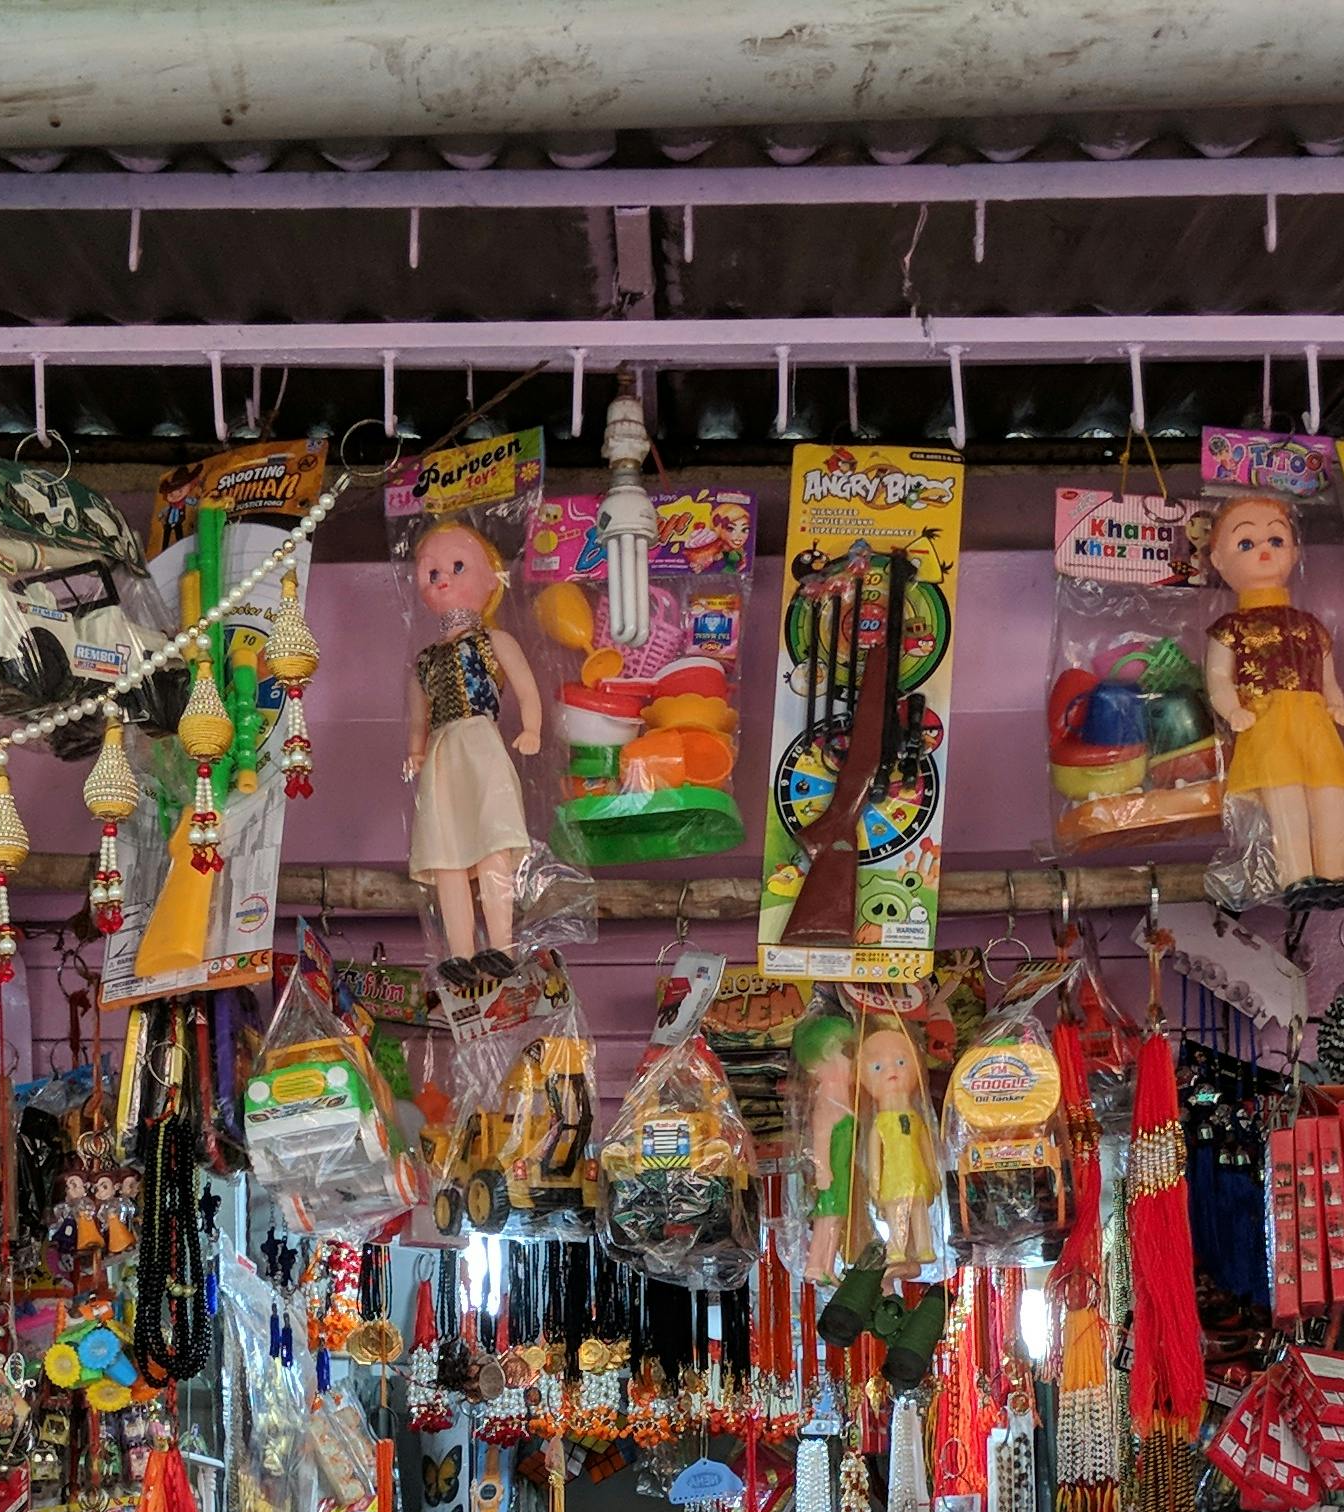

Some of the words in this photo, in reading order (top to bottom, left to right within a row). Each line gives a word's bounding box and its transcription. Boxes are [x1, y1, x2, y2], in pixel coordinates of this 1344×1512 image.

[218, 464, 287, 490] SHOOTING
[412, 438, 522, 497] Parveen
[804, 469, 879, 503] ANGRY
[1090, 518, 1174, 542] Khana
[1075, 539, 1169, 562] Khazana
[970, 1077, 1032, 1091] GOOGLE
